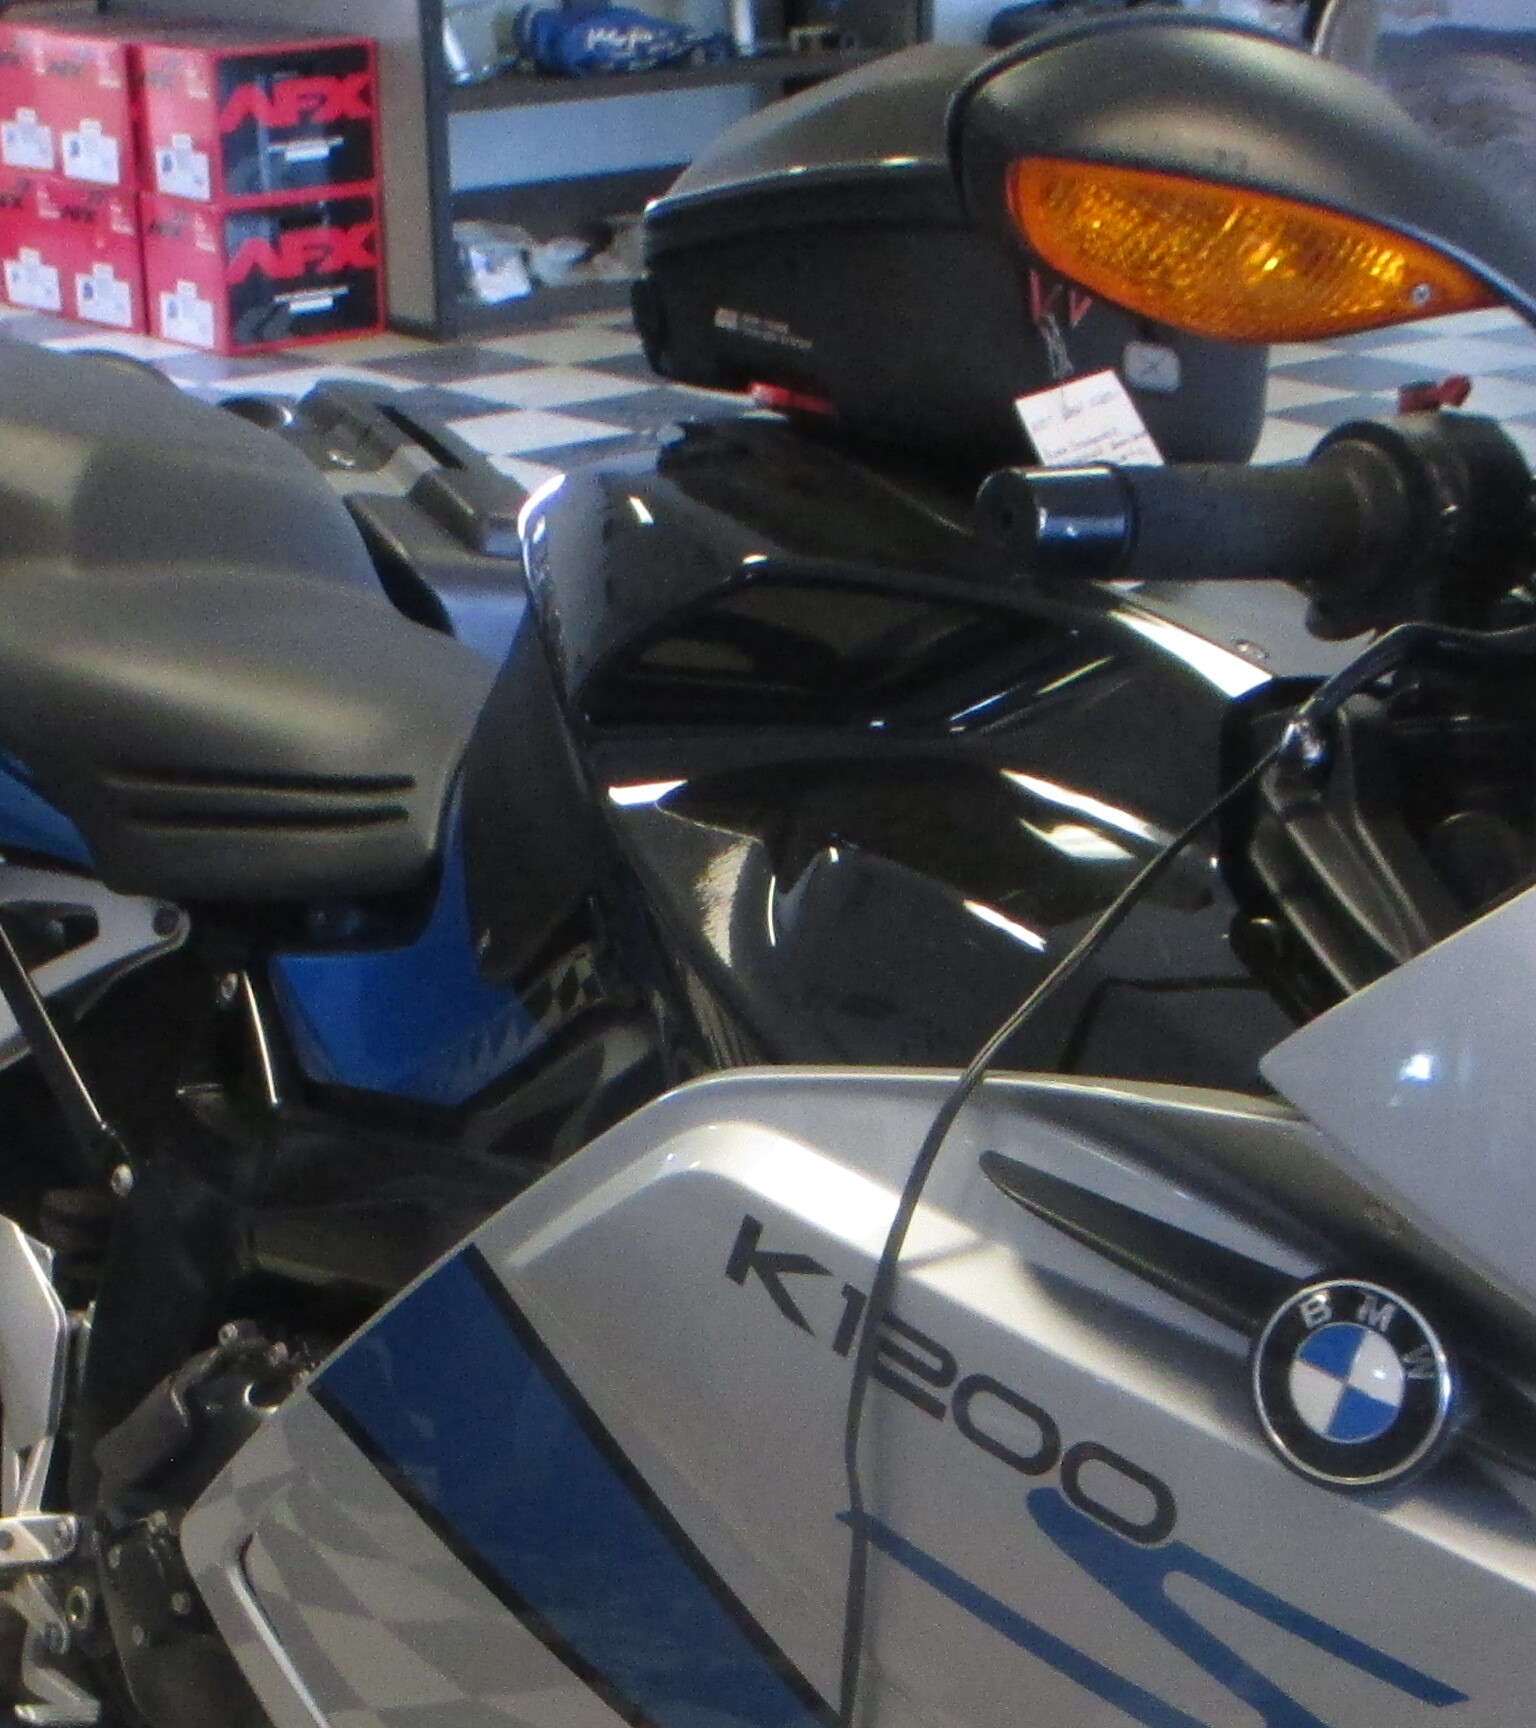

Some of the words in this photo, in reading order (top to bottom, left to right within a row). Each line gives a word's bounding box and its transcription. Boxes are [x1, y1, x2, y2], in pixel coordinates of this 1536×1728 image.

[218, 73, 372, 133] AFX
[222, 223, 376, 285] AFX
[1298, 1288, 1437, 1381] BMW
